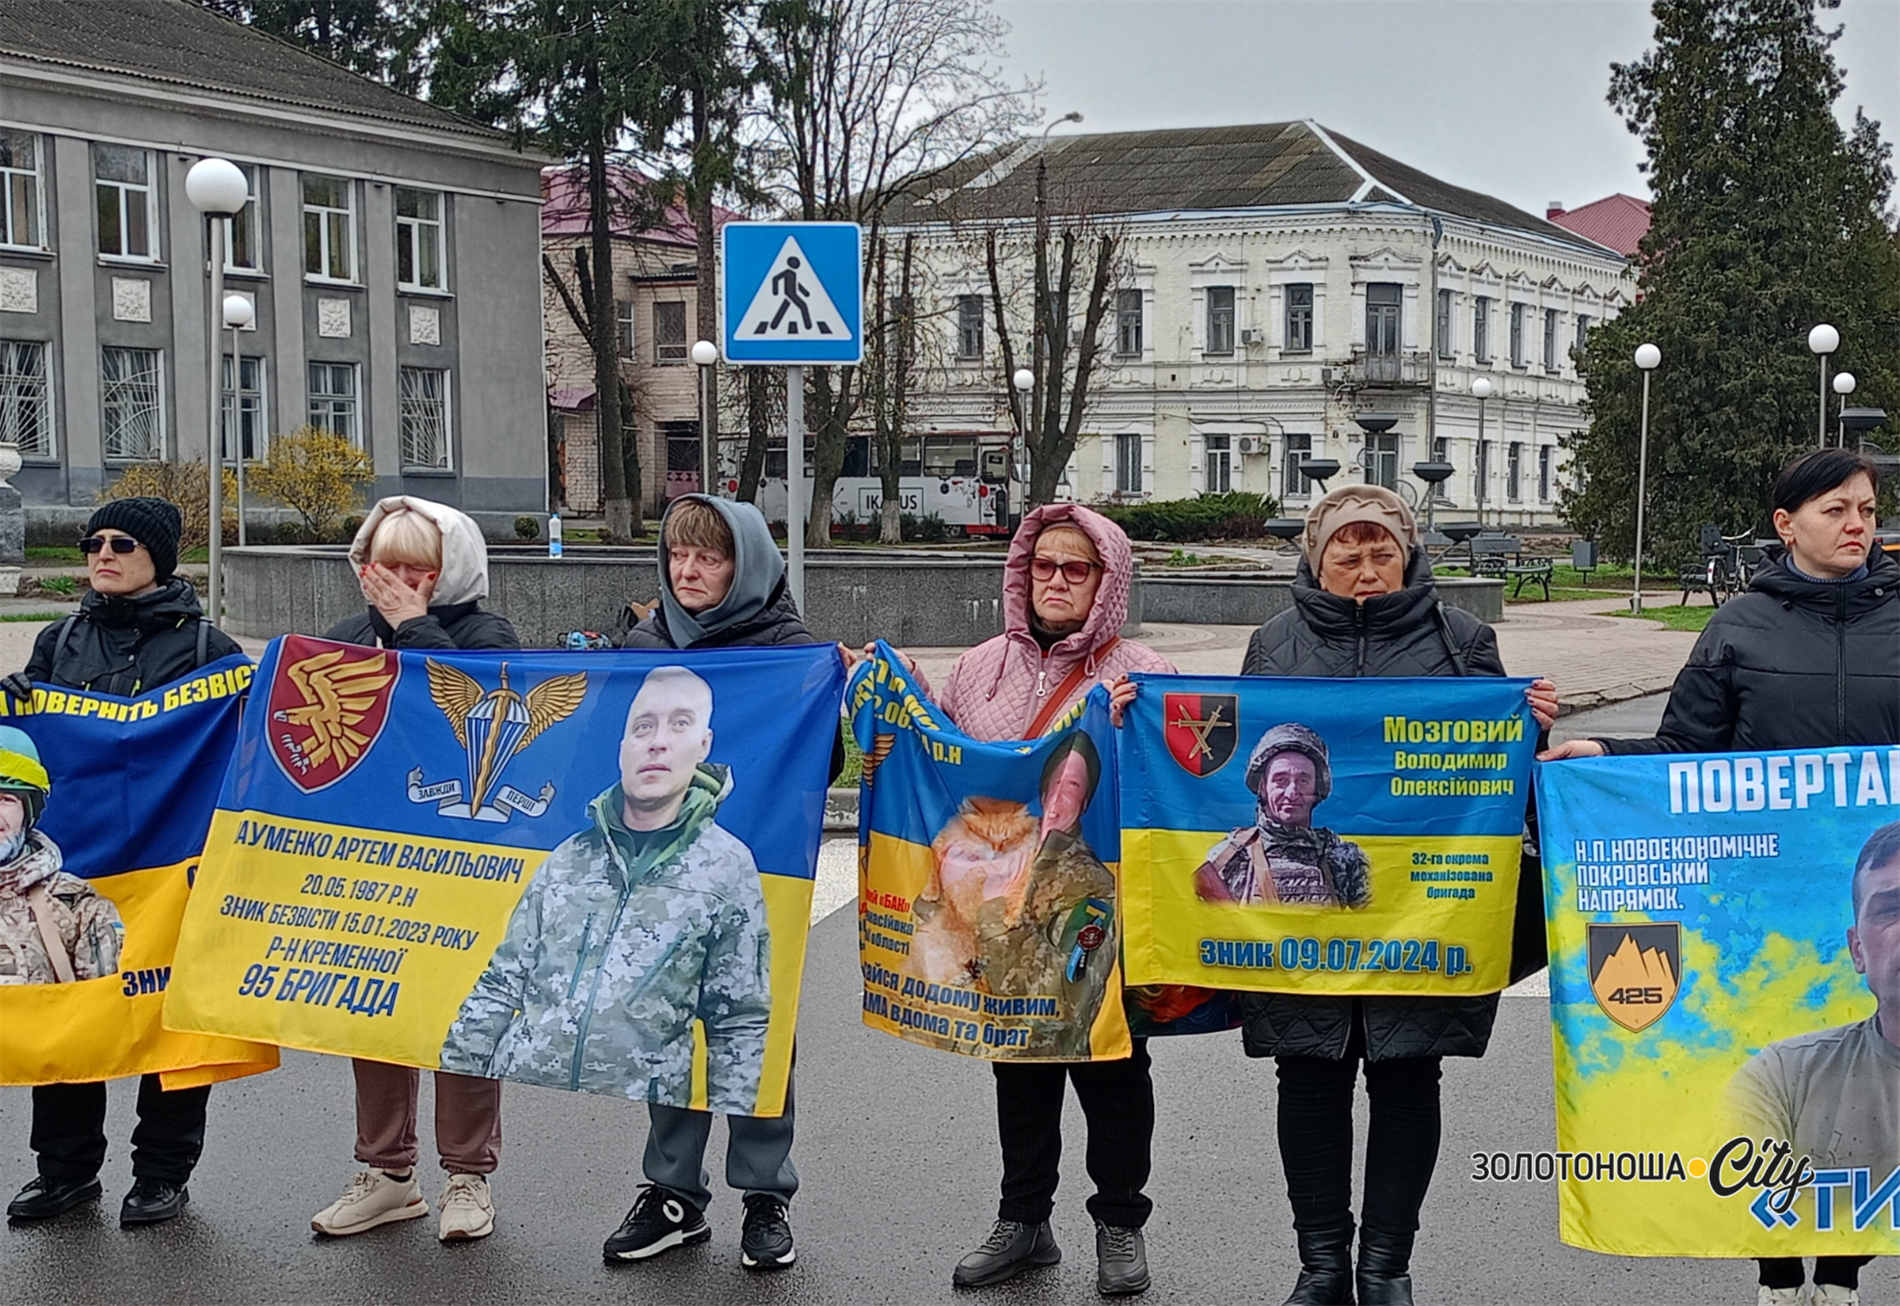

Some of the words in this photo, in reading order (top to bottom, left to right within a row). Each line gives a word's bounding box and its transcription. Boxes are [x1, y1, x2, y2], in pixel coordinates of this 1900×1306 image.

[866, 494, 918, 510] IKUS
[1384, 714, 1524, 744] Мозговий
[1395, 751, 1508, 772] Володимир
[418, 783, 456, 800] ЗАВЖДИ
[506, 790, 536, 812] ПЕРШІ
[1391, 776, 1514, 796] Олексійович
[234, 820, 333, 858] АУМЕНКО
[331, 836, 398, 867] АРТЕМ
[396, 844, 525, 884] ВАСИЛЬОВИЧ
[1412, 853, 1443, 866] 32-га
[1445, 854, 1489, 866] окрема
[1411, 870, 1493, 882] механізована
[1576, 859, 1709, 887] ПОКРОВСЬКИЙ
[300, 874, 389, 903] 20.05.1987
[387, 884, 419, 907] Р.Н
[1427, 887, 1475, 900] бригада
[1577, 887, 1685, 912] НАПРЯМОК.
[220, 895, 270, 923] ЗНИК
[268, 903, 340, 931] БЕЗВІСТИ
[341, 911, 431, 944] 15.01.2023
[430, 925, 480, 951] РОКУ
[265, 936, 301, 962] Р-Н
[298, 939, 409, 975] КРЕМЕННОЇ
[1280, 937, 1440, 972] 09.07.2024
[1445, 946, 1473, 977] р.
[239, 963, 280, 998] 95
[275, 968, 400, 1018] БРИГАДА
[901, 976, 981, 1012] додому
[983, 995, 1060, 1018] живим,
[1608, 987, 1663, 1004] 425
[890, 1003, 949, 1036] вдома
[954, 1019, 979, 1042] та
[982, 1022, 1030, 1049] брат
